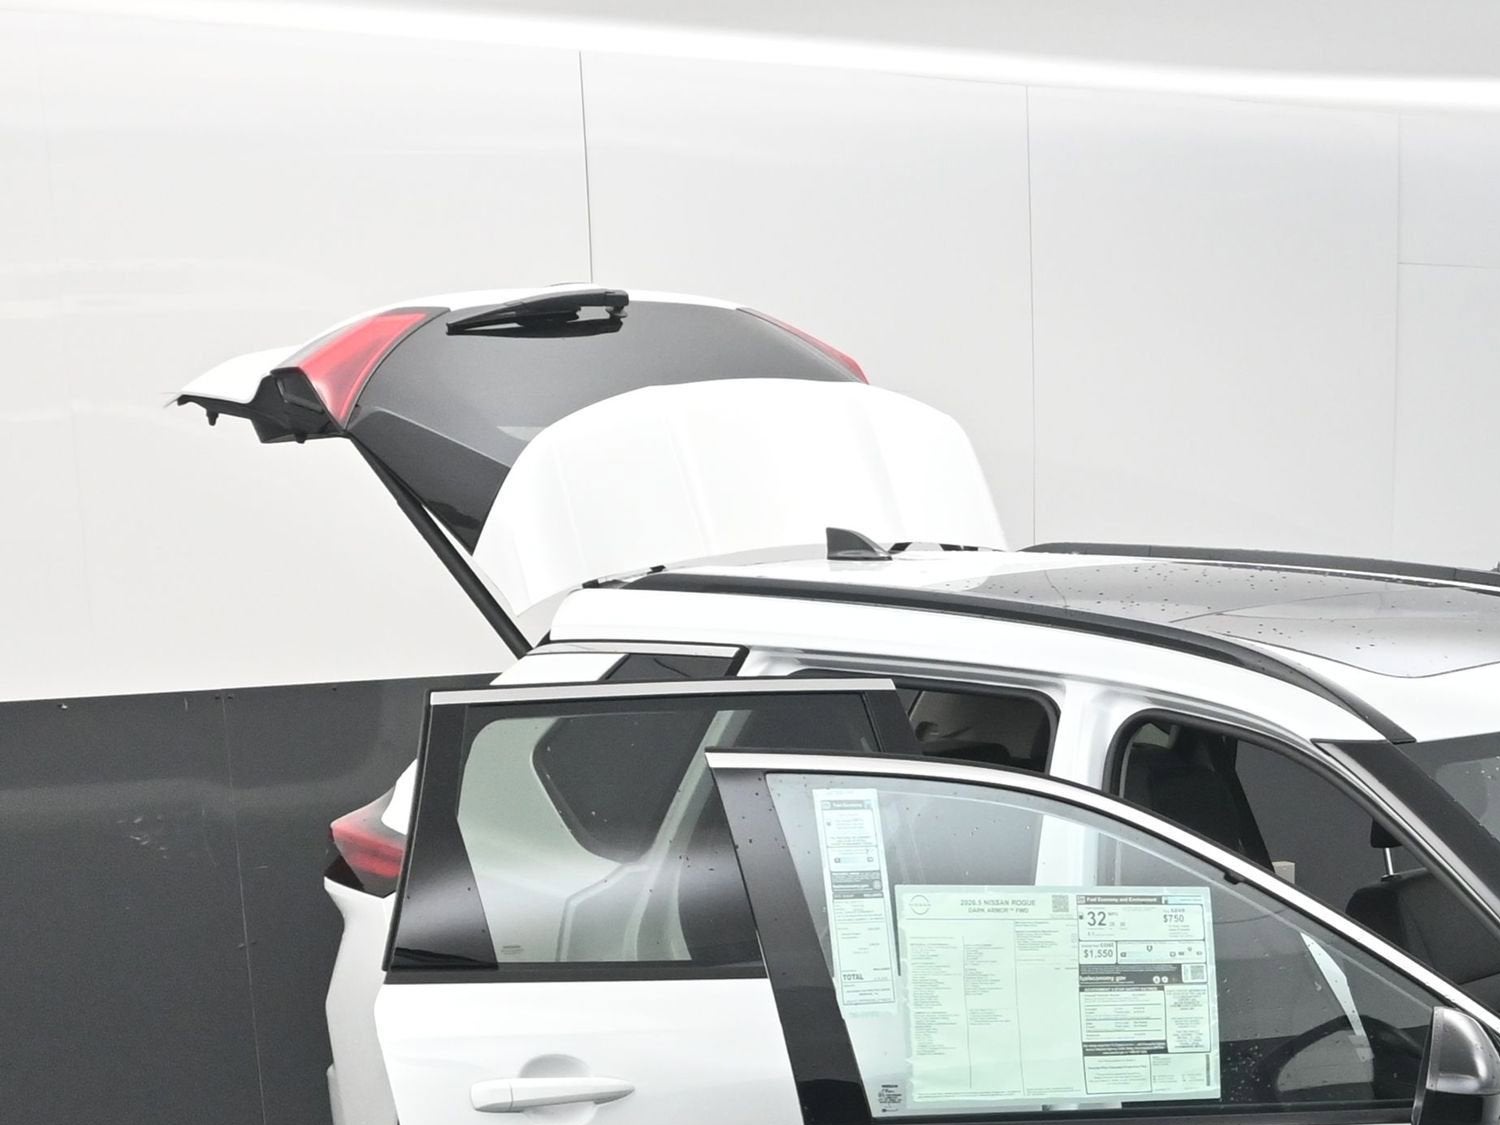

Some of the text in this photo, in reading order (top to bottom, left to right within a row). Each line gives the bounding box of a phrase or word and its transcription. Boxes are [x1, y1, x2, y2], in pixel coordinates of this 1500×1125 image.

[1087, 911, 1107, 927] 32
[1162, 914, 1185, 923] $750
[1083, 949, 1114, 959] $1,550
[842, 973, 864, 981] TOTAL
